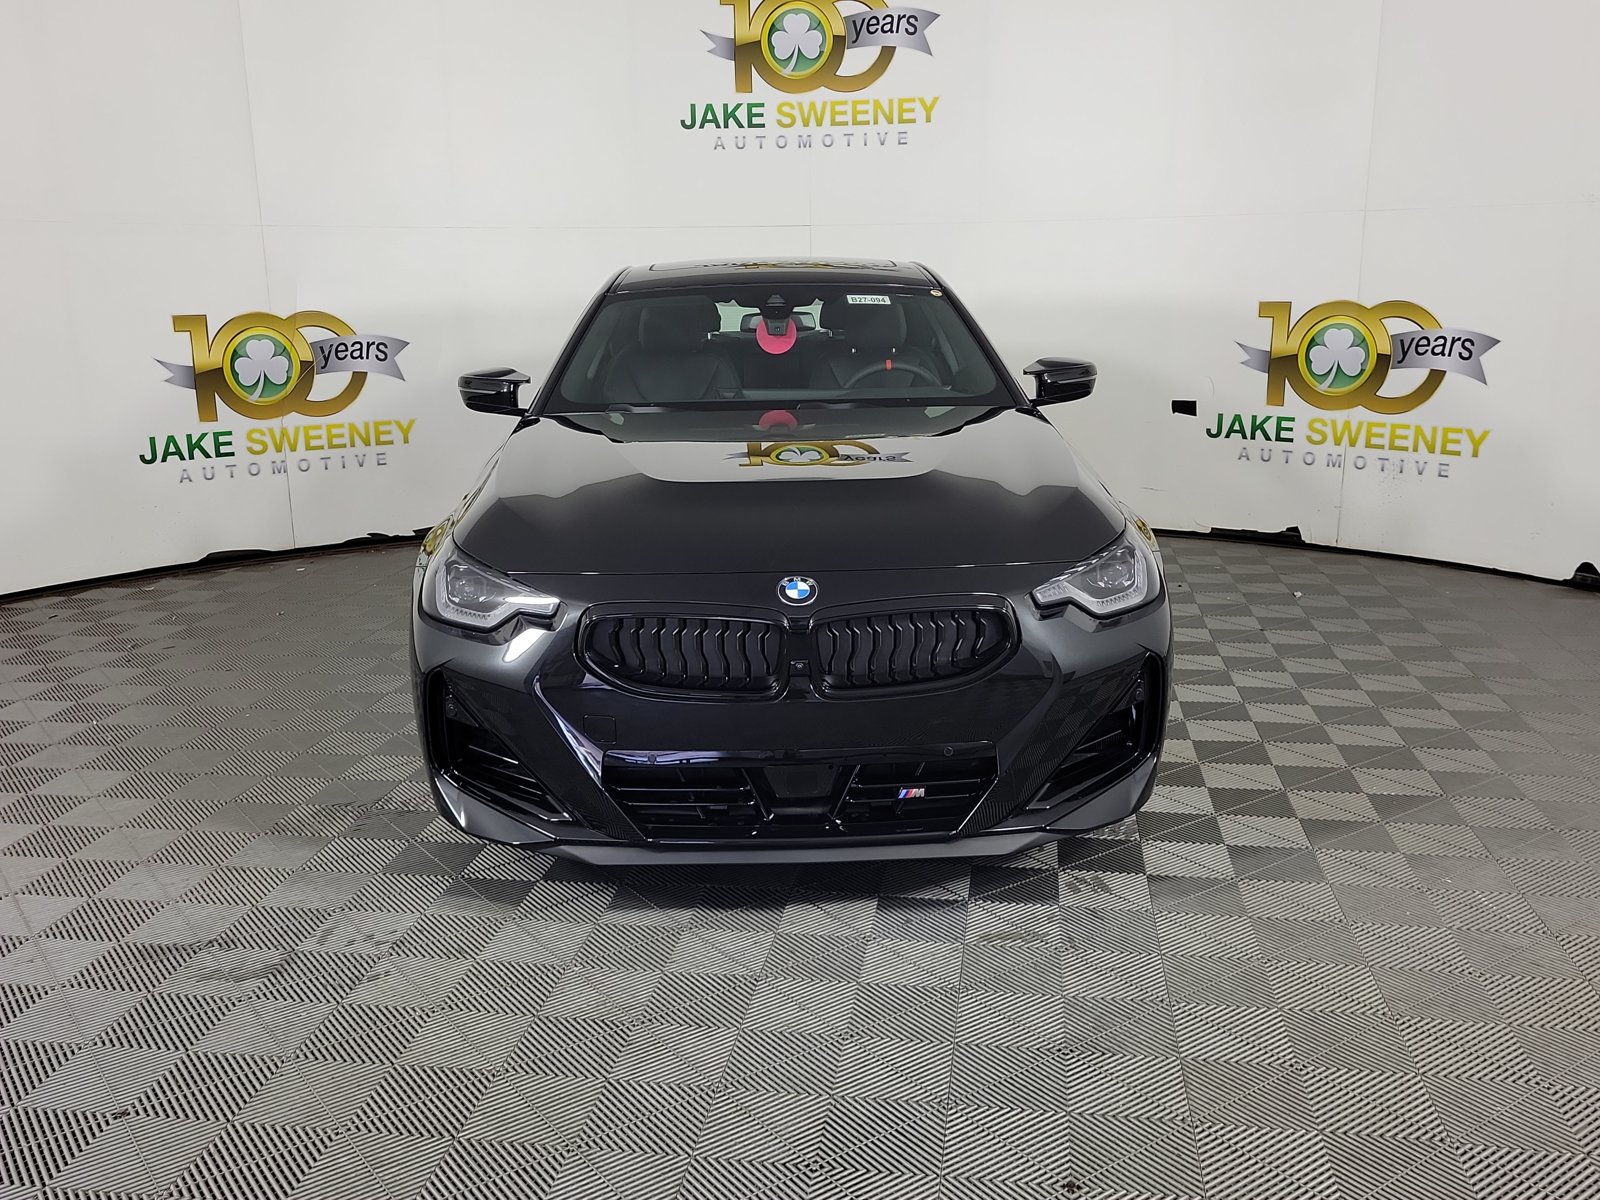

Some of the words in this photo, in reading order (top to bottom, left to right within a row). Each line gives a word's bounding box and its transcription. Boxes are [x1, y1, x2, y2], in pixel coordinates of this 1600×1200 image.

[851, 13, 919, 44] years
[680, 102, 766, 130] JAKE
[776, 96, 941, 129] SWEENEY
[713, 131, 908, 150] AUTOMOTIVE
[850, 296, 887, 304] B27-094
[318, 340, 389, 370] years
[1396, 334, 1475, 364] years
[138, 430, 236, 465] JAKE
[245, 418, 416, 456] SWEENEY
[1205, 413, 1296, 443] JAKE
[1305, 417, 1494, 459] SWEENEY
[178, 452, 388, 484] AUTOMOTIVE
[1237, 447, 1450, 478] AUTOMOTIVE
